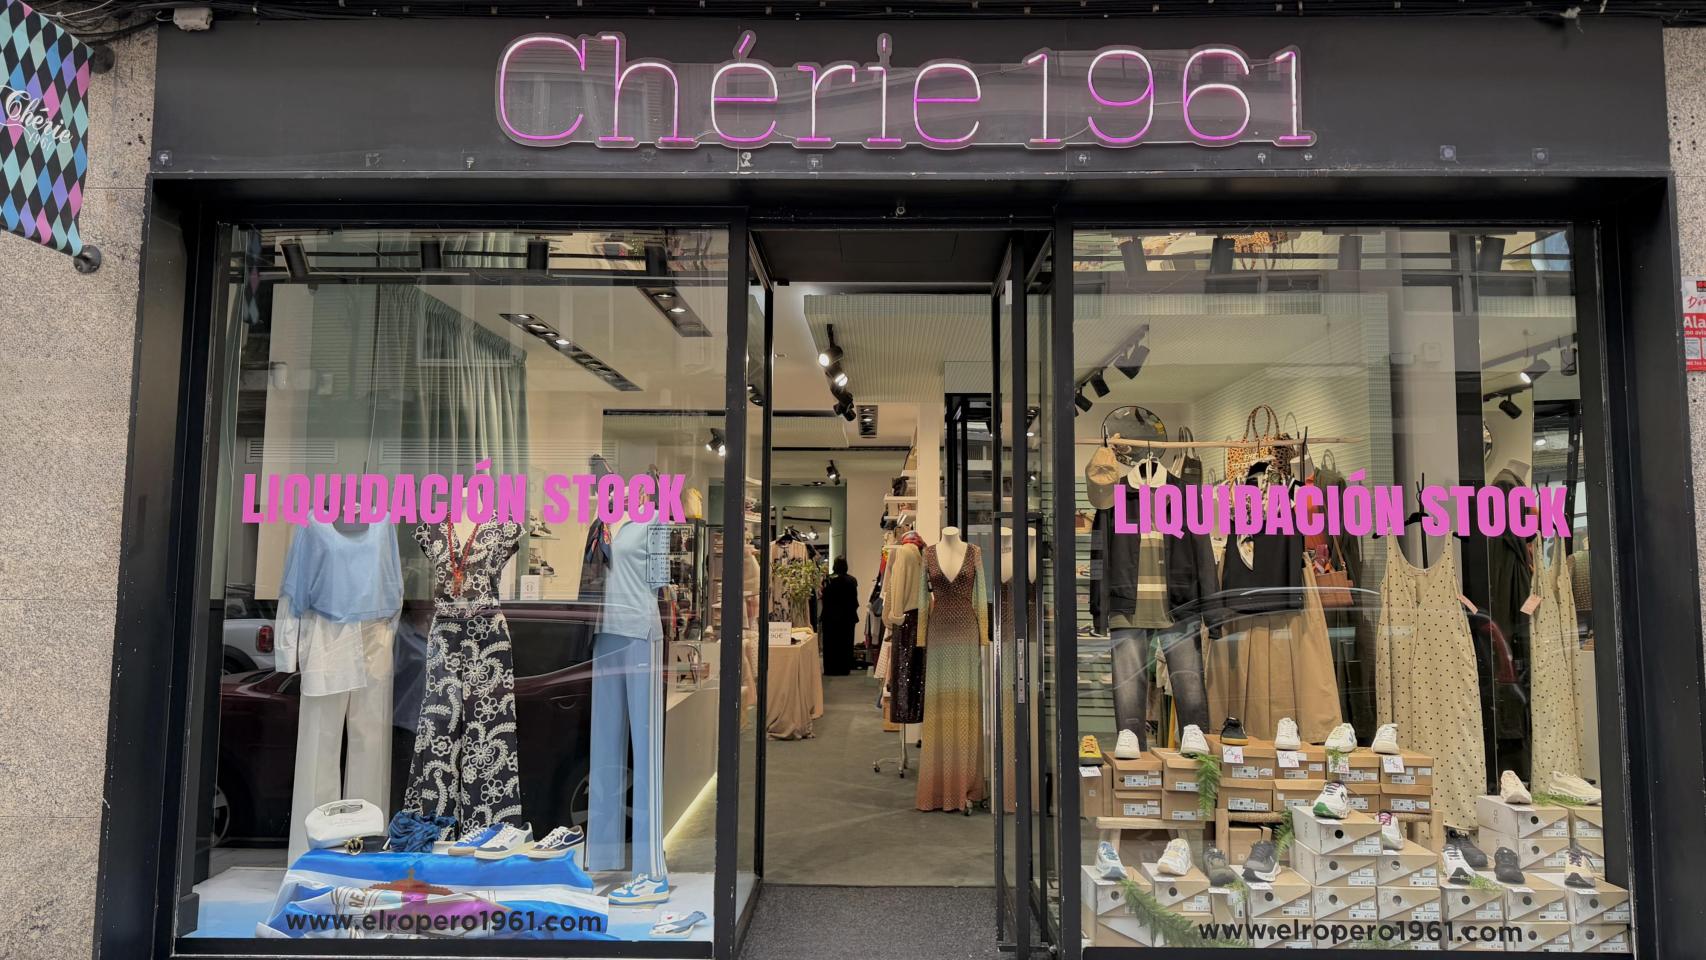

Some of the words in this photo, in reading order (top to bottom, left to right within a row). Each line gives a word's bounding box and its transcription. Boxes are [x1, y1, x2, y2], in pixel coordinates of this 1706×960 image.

[4, 88, 74, 144] Chérie
[499, 33, 981, 143] Chérie
[1026, 48, 1312, 143] 1961
[29, 131, 54, 151] 1961
[242, 457, 527, 527] LIQUIDACIÓN
[543, 473, 688, 524] STOCK
[1114, 468, 1405, 539] LIQUIDACIÓN
[1421, 484, 1572, 538] STOCK
[286, 910, 603, 935] www.elropero1961.com
[1198, 918, 1523, 945] www.elropero1961.com
